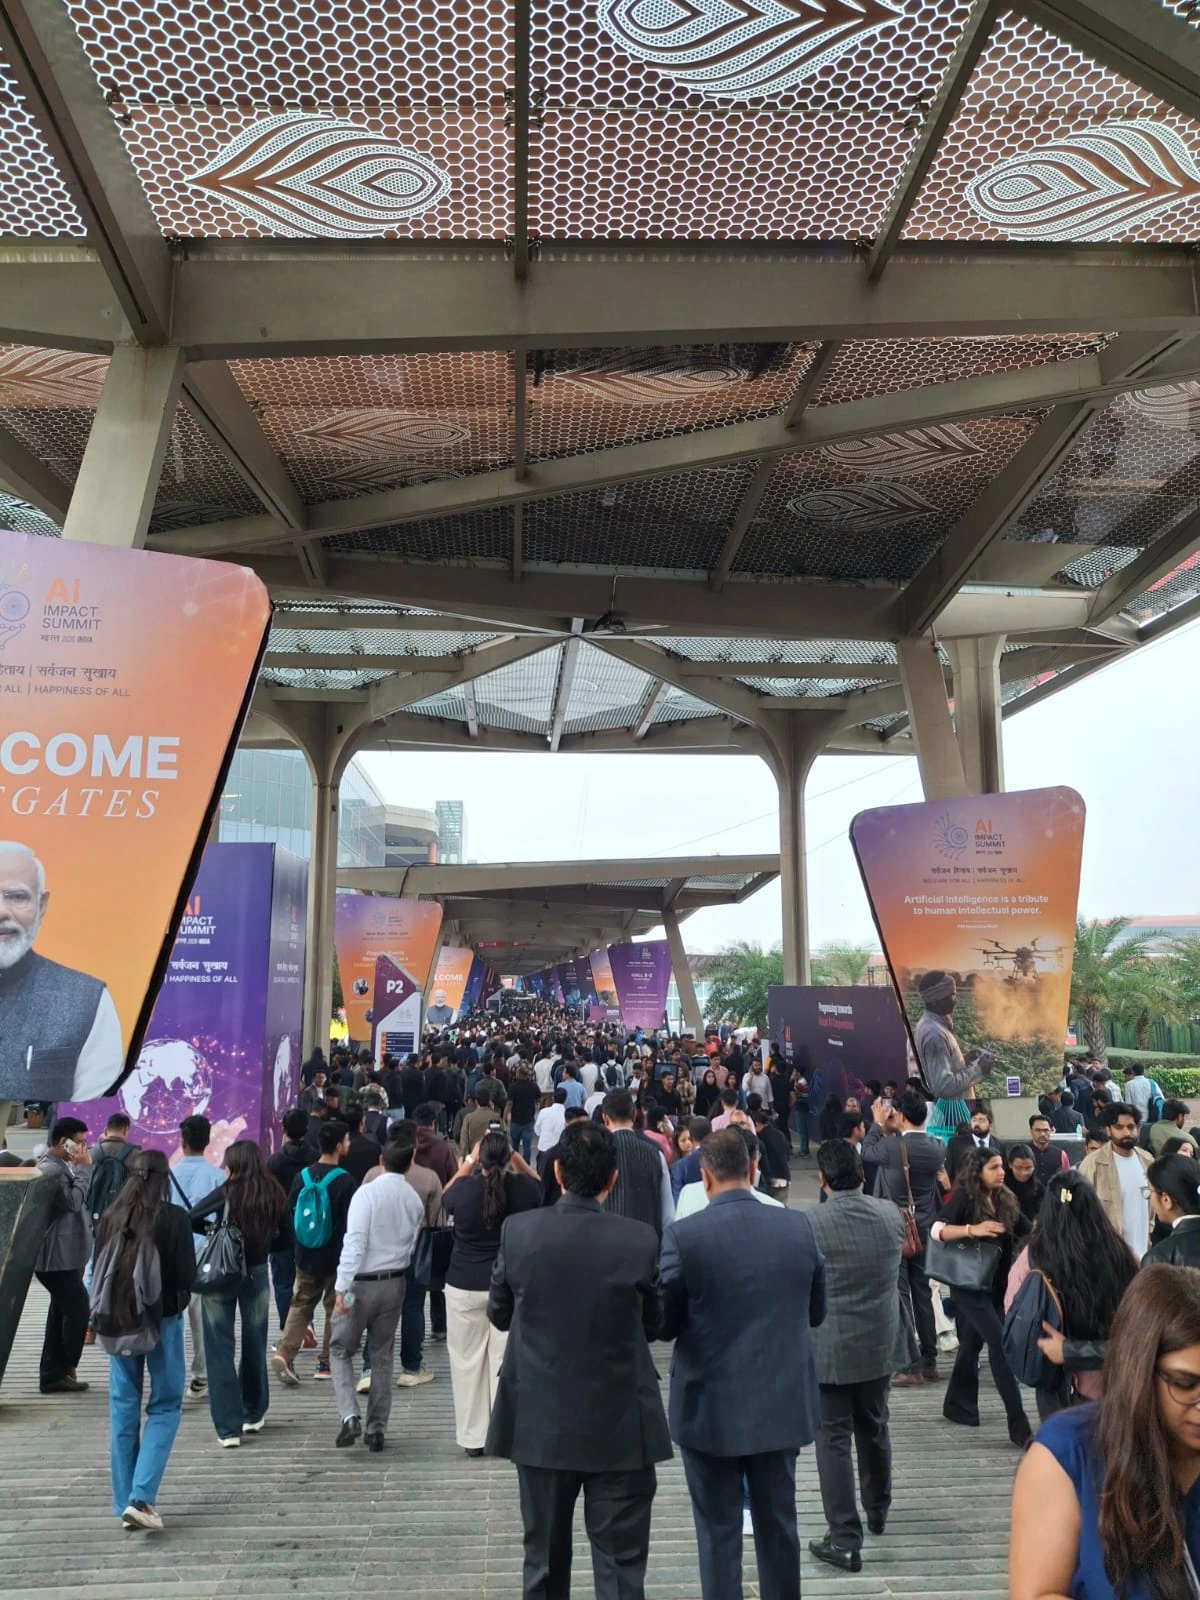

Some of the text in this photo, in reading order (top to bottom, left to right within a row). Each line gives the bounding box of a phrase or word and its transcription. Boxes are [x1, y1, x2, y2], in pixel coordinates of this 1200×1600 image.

[45, 577, 80, 604] AI
[43, 605, 99, 617] IMPACT
[42, 618, 102, 630] SUMMIT
[4, 684, 130, 696] ALL HAPPINESS OF ALL
[0, 731, 180, 779] COME
[0, 786, 160, 818] GATES
[976, 819, 992, 833] AI
[904, 895, 944, 903] Artificial
[1001, 895, 1009, 903] is
[1018, 895, 1049, 903] tribute
[913, 907, 923, 915] to
[925, 907, 956, 915] human
[1011, 907, 1041, 915] power.
[386, 980, 404, 994] P2
